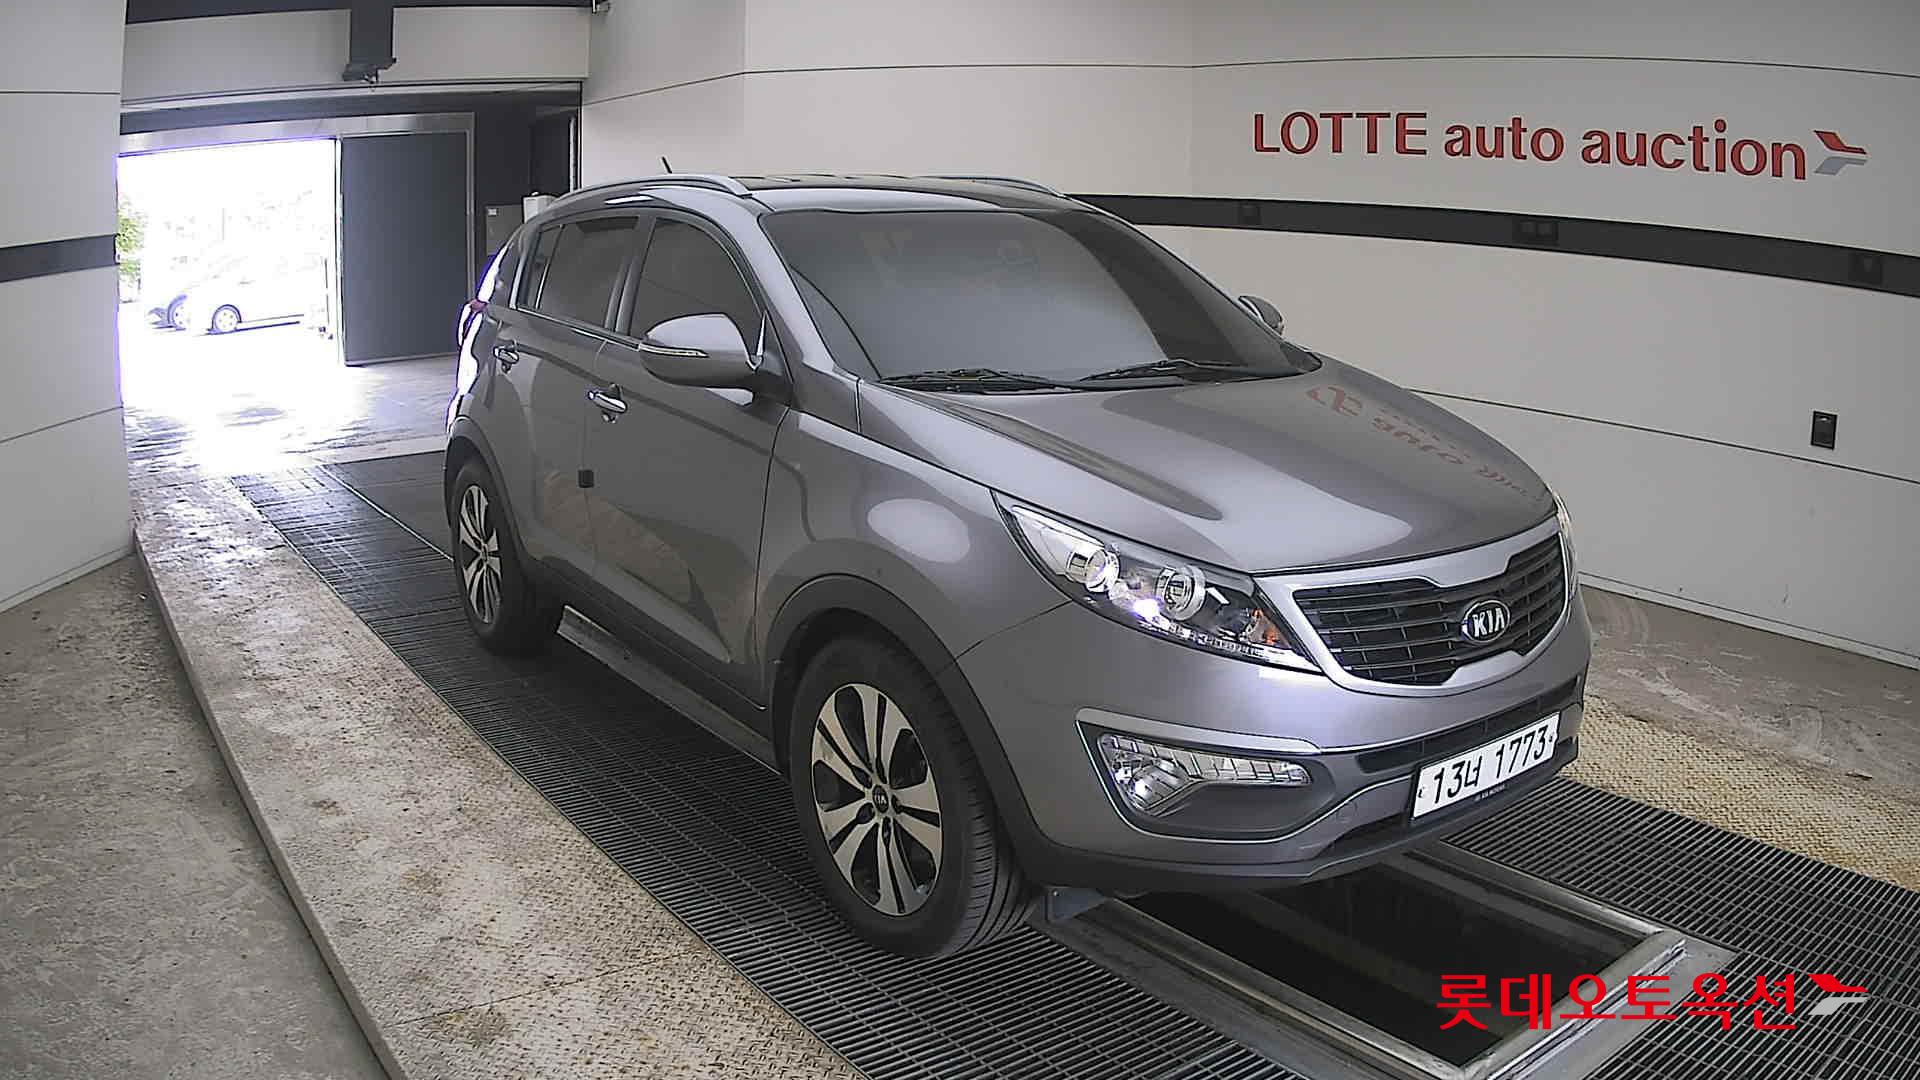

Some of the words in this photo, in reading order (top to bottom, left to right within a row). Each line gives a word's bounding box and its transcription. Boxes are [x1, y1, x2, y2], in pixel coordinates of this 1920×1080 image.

[1253, 111, 1428, 155] LOTTE
[1445, 117, 1565, 162] auto
[1581, 118, 1806, 181] auction
[1472, 606, 1506, 637] KIA
[1434, 757, 1482, 803] 13너
[1496, 725, 1547, 778] 1773
